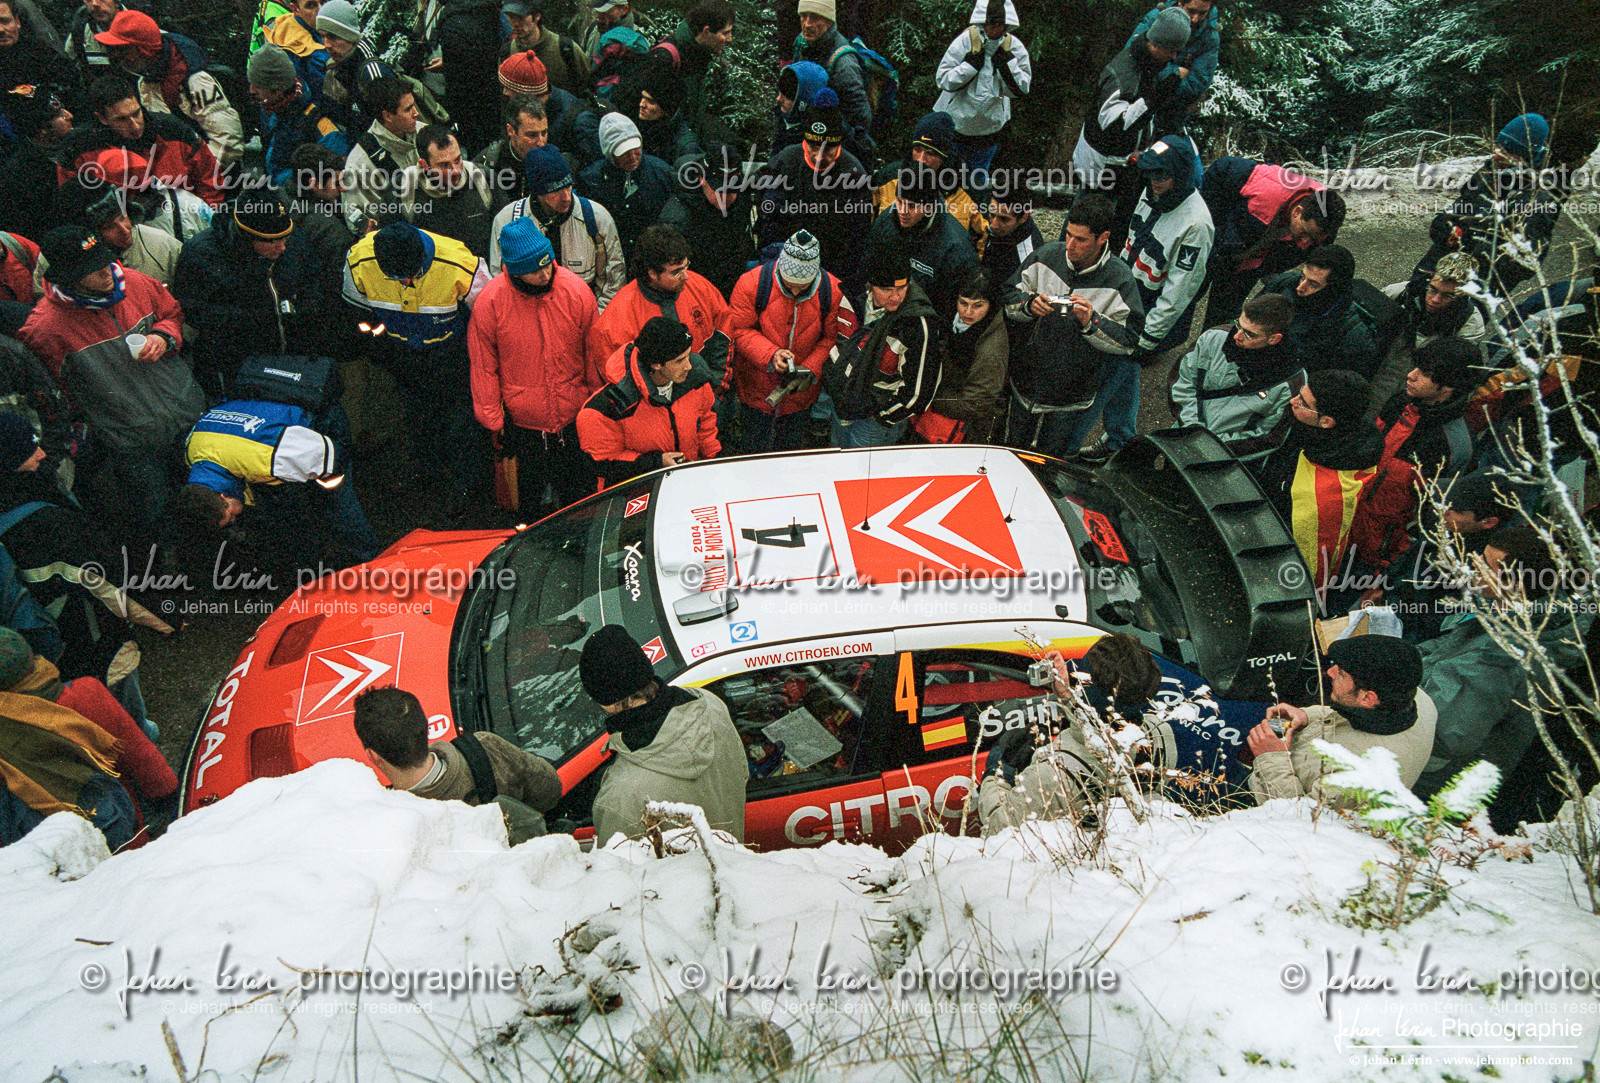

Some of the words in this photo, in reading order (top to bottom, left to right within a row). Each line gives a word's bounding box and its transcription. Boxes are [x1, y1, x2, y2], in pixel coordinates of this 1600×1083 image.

[691, 525, 703, 552] 2004
[741, 524, 819, 548] 4
[624, 541, 642, 601] Xsara
[744, 642, 873, 668] WWW.CITROEN.COM
[1247, 652, 1297, 668] TOTAL
[895, 652, 918, 724] 4
[196, 650, 255, 790] TOTAL
[979, 698, 1059, 737] Sain
[784, 775, 979, 844] CITRO
